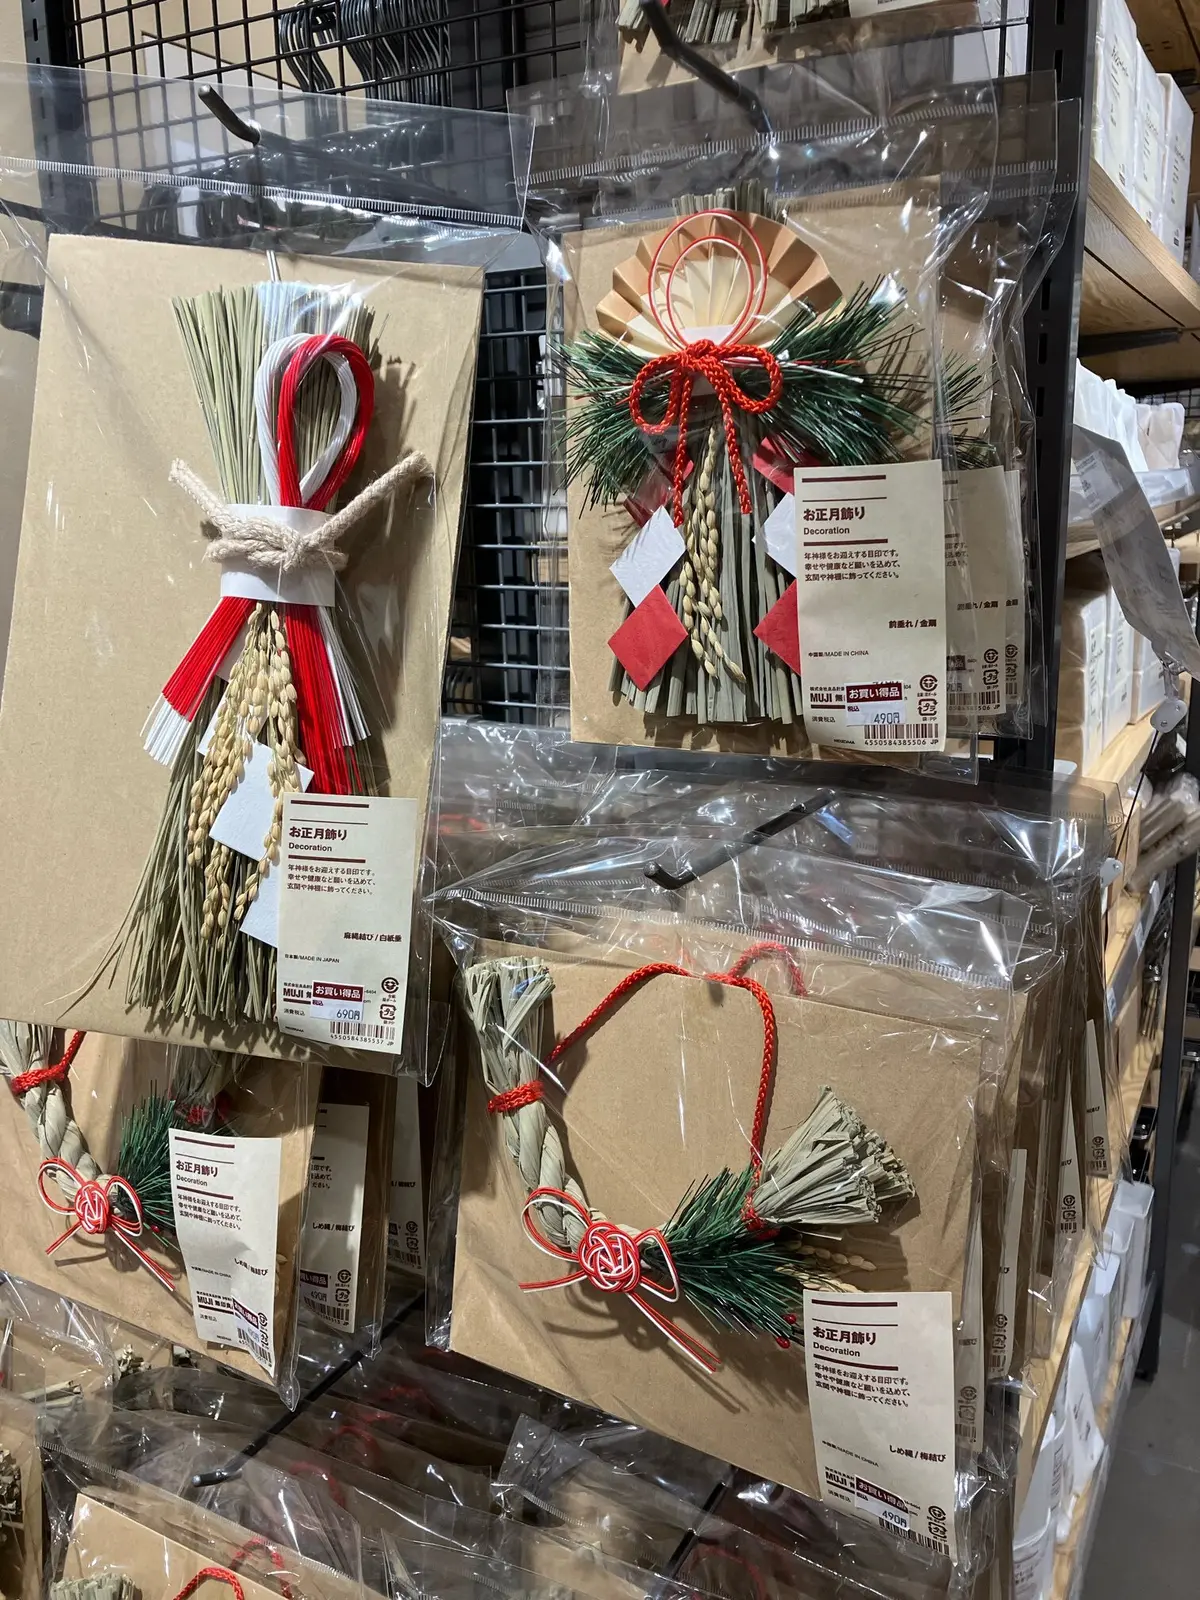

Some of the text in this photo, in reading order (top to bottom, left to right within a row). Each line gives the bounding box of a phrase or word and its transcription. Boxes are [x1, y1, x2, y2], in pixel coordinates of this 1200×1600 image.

[803, 506, 866, 522] お正月飾り
[803, 526, 850, 535] Decoration
[810, 693, 832, 702] MUJI
[848, 687, 900, 699] お買い得品
[873, 712, 900, 724] 490円
[289, 826, 347, 841] お正月飾り
[288, 842, 333, 852] Decoration
[283, 988, 304, 998] MUJI
[315, 985, 361, 999] お買い得品
[336, 1009, 361, 1021] 690円
[176, 1159, 218, 1177] お正月飾り
[176, 1174, 208, 1187] Decoration
[197, 1295, 214, 1306] MUJI
[813, 1326, 876, 1345] お正月飾り
[813, 1342, 860, 1357] Decoration
[825, 1471, 848, 1487] MUJI
[858, 1480, 908, 1511] お買い得品
[882, 1510, 907, 1528] 490円
